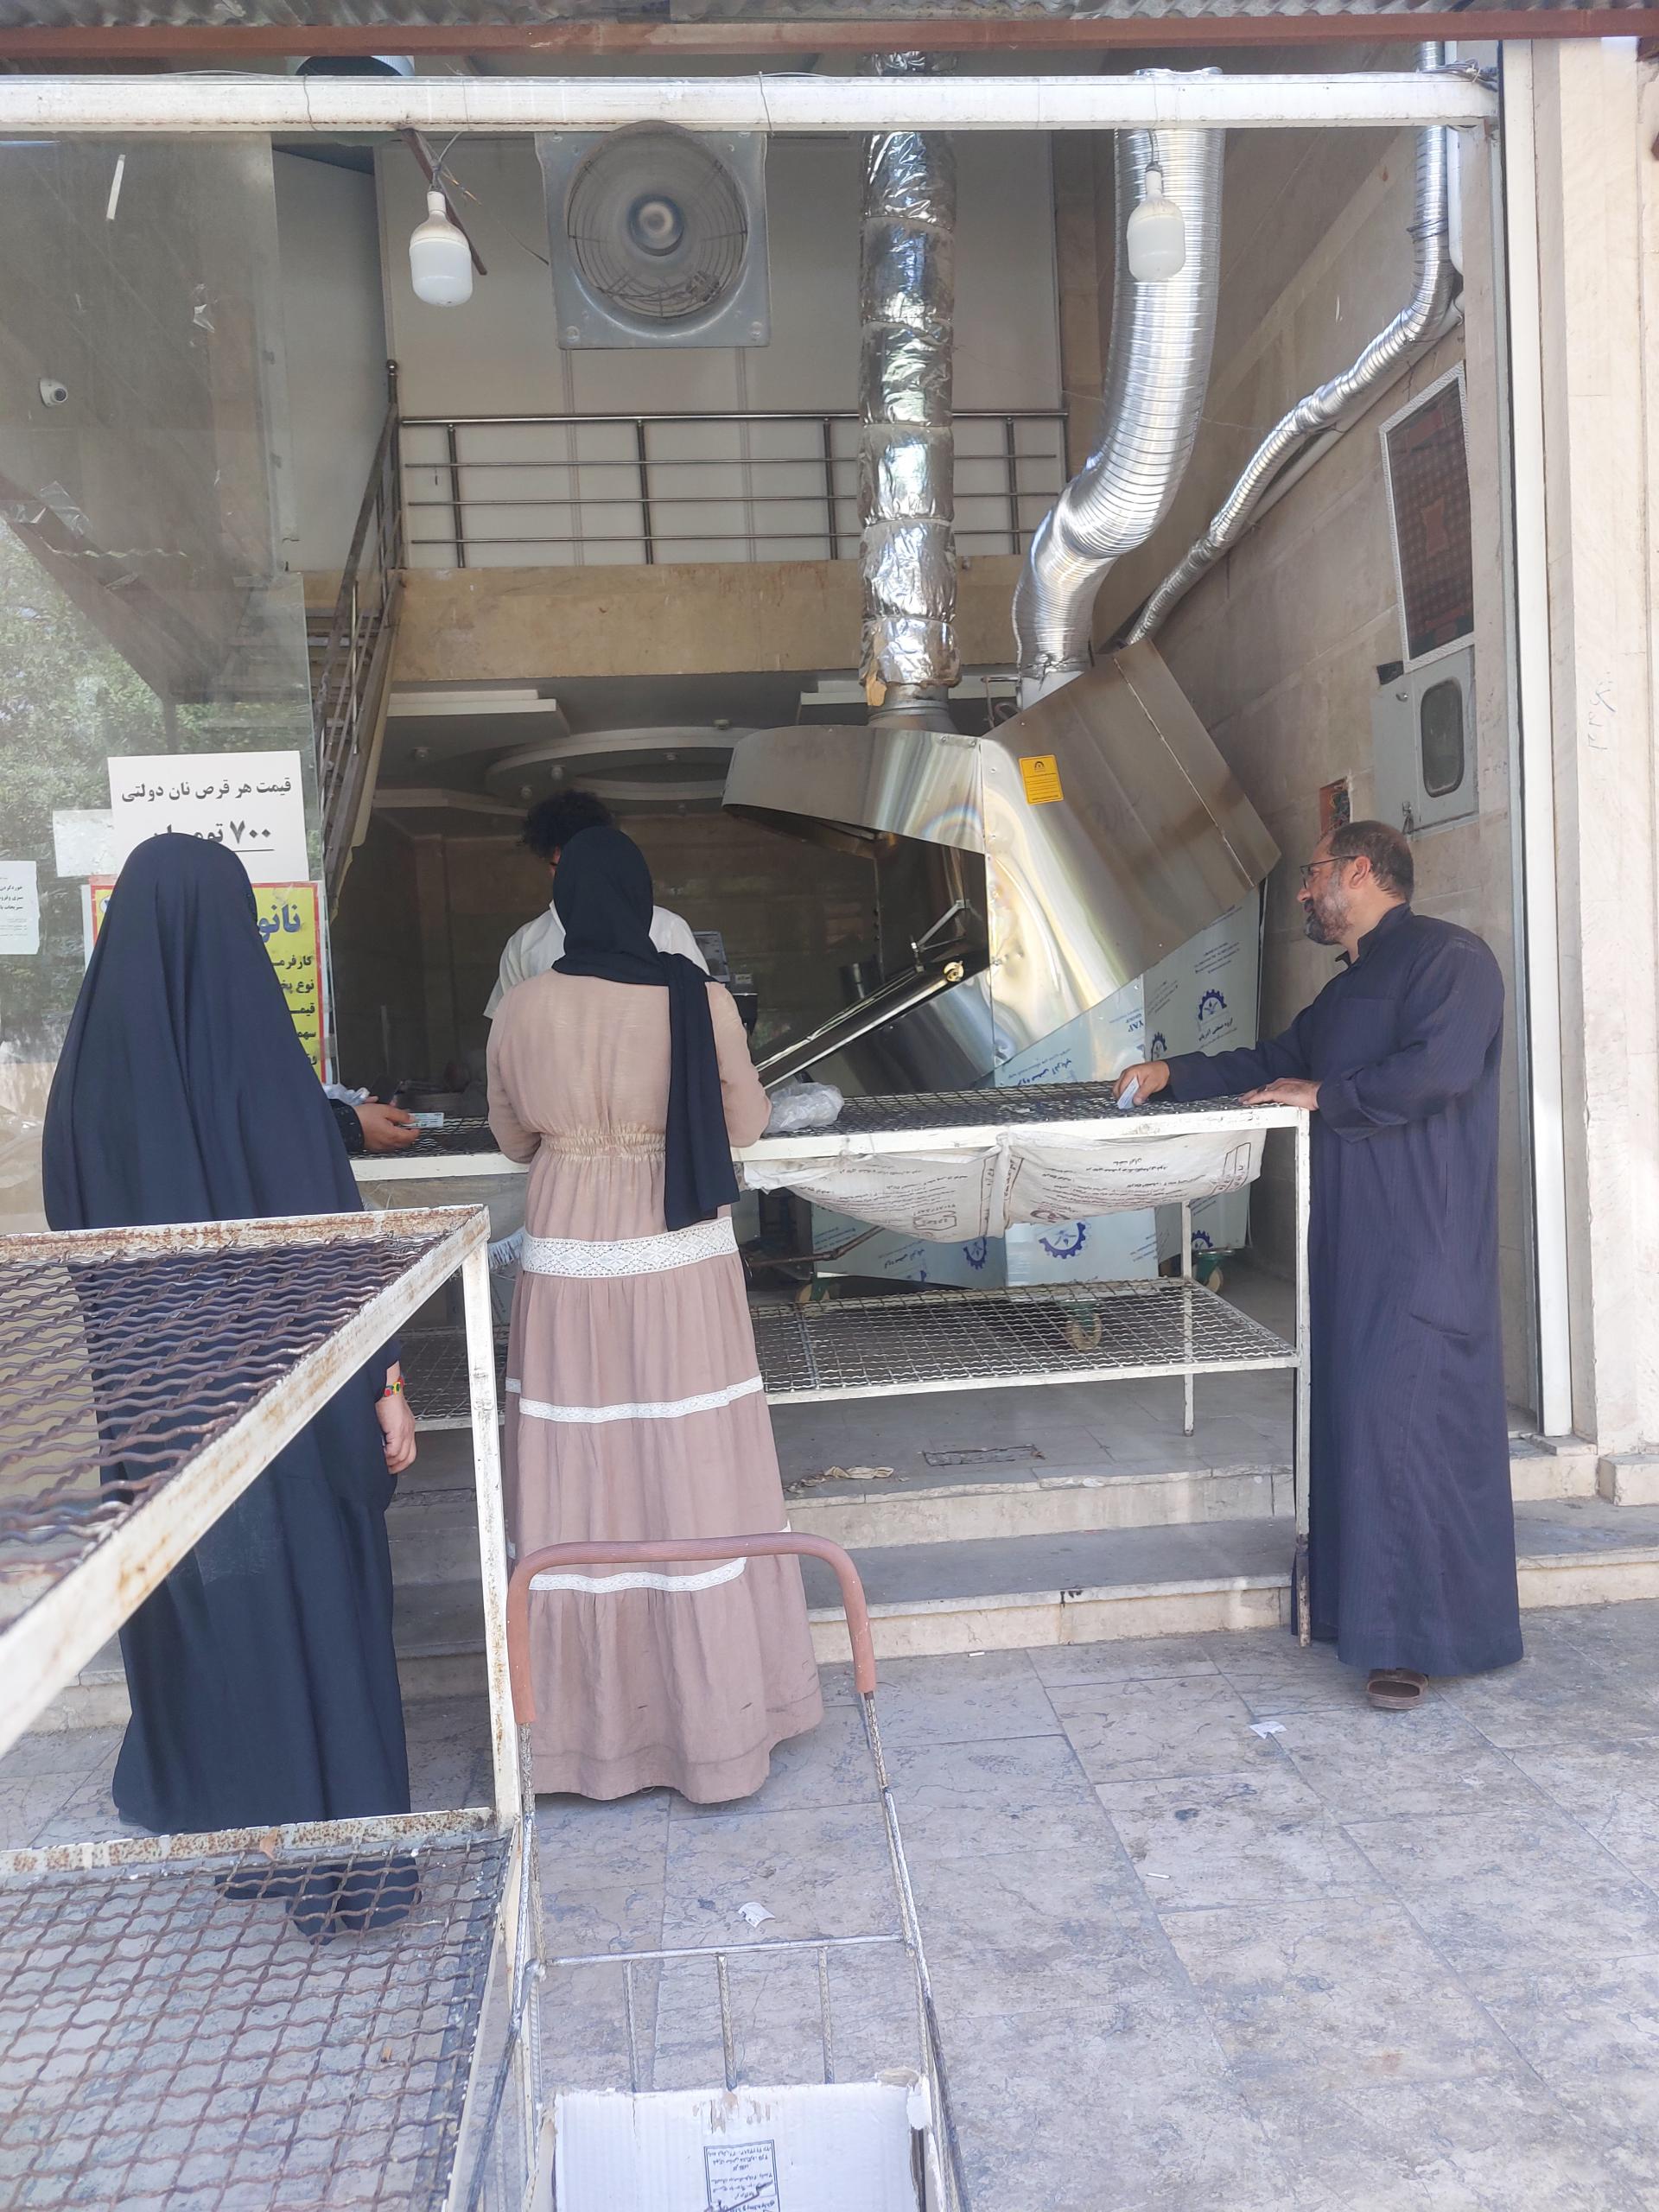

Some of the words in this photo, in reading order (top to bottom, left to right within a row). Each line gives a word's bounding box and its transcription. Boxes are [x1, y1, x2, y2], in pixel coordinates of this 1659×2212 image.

[121, 784, 164, 802] دولتی
[168, 782, 190, 800] نان
[195, 779, 230, 799] قرص
[235, 783, 252, 798] هر
[256, 777, 292, 796] قیمت
[229, 820, 271, 844] ۷۰۰
[271, 954, 313, 970] کارفرم
[296, 980, 315, 994] نوع
[289, 1003, 315, 1017] قیم
